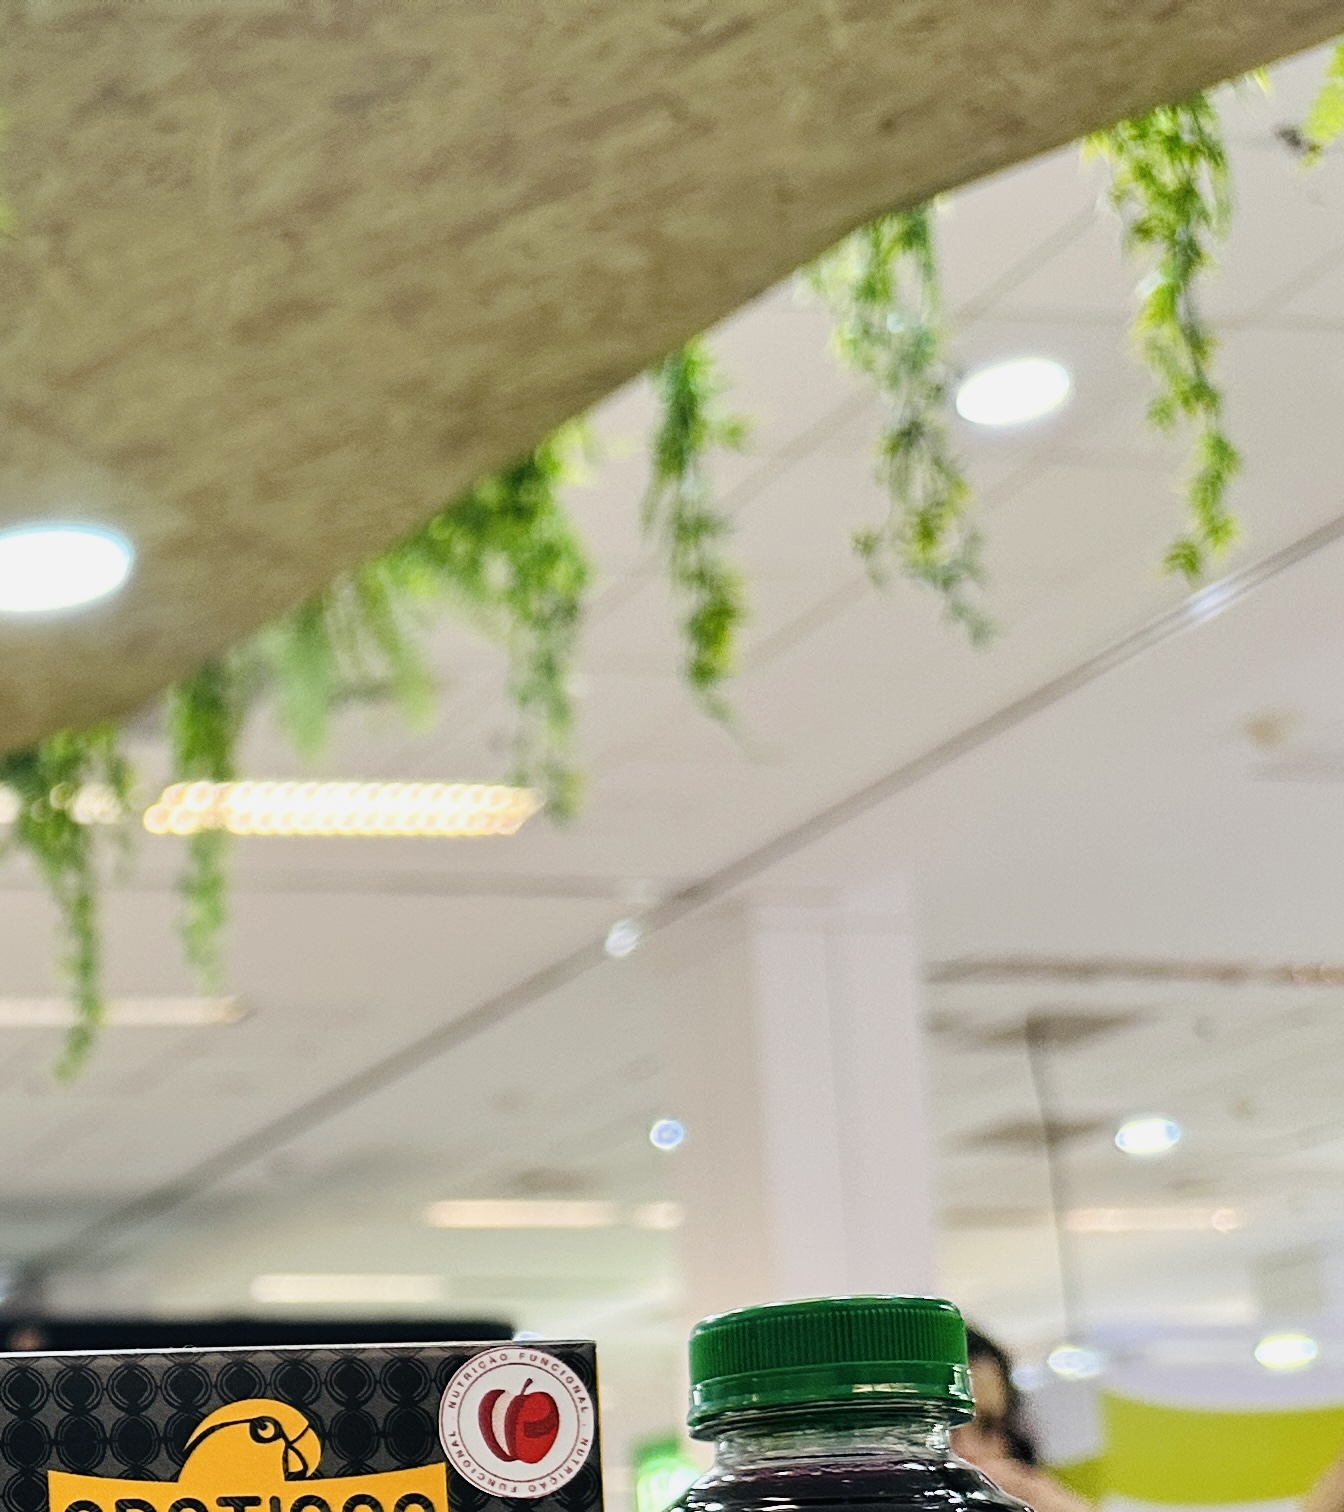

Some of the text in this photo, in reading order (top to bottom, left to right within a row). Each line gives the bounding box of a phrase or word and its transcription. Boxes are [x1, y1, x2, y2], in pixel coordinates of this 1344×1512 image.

[448, 1352, 590, 1414] NUTRIÇÃO FUNCIONAL
[447, 1430, 518, 1494] FUNCIONAL
